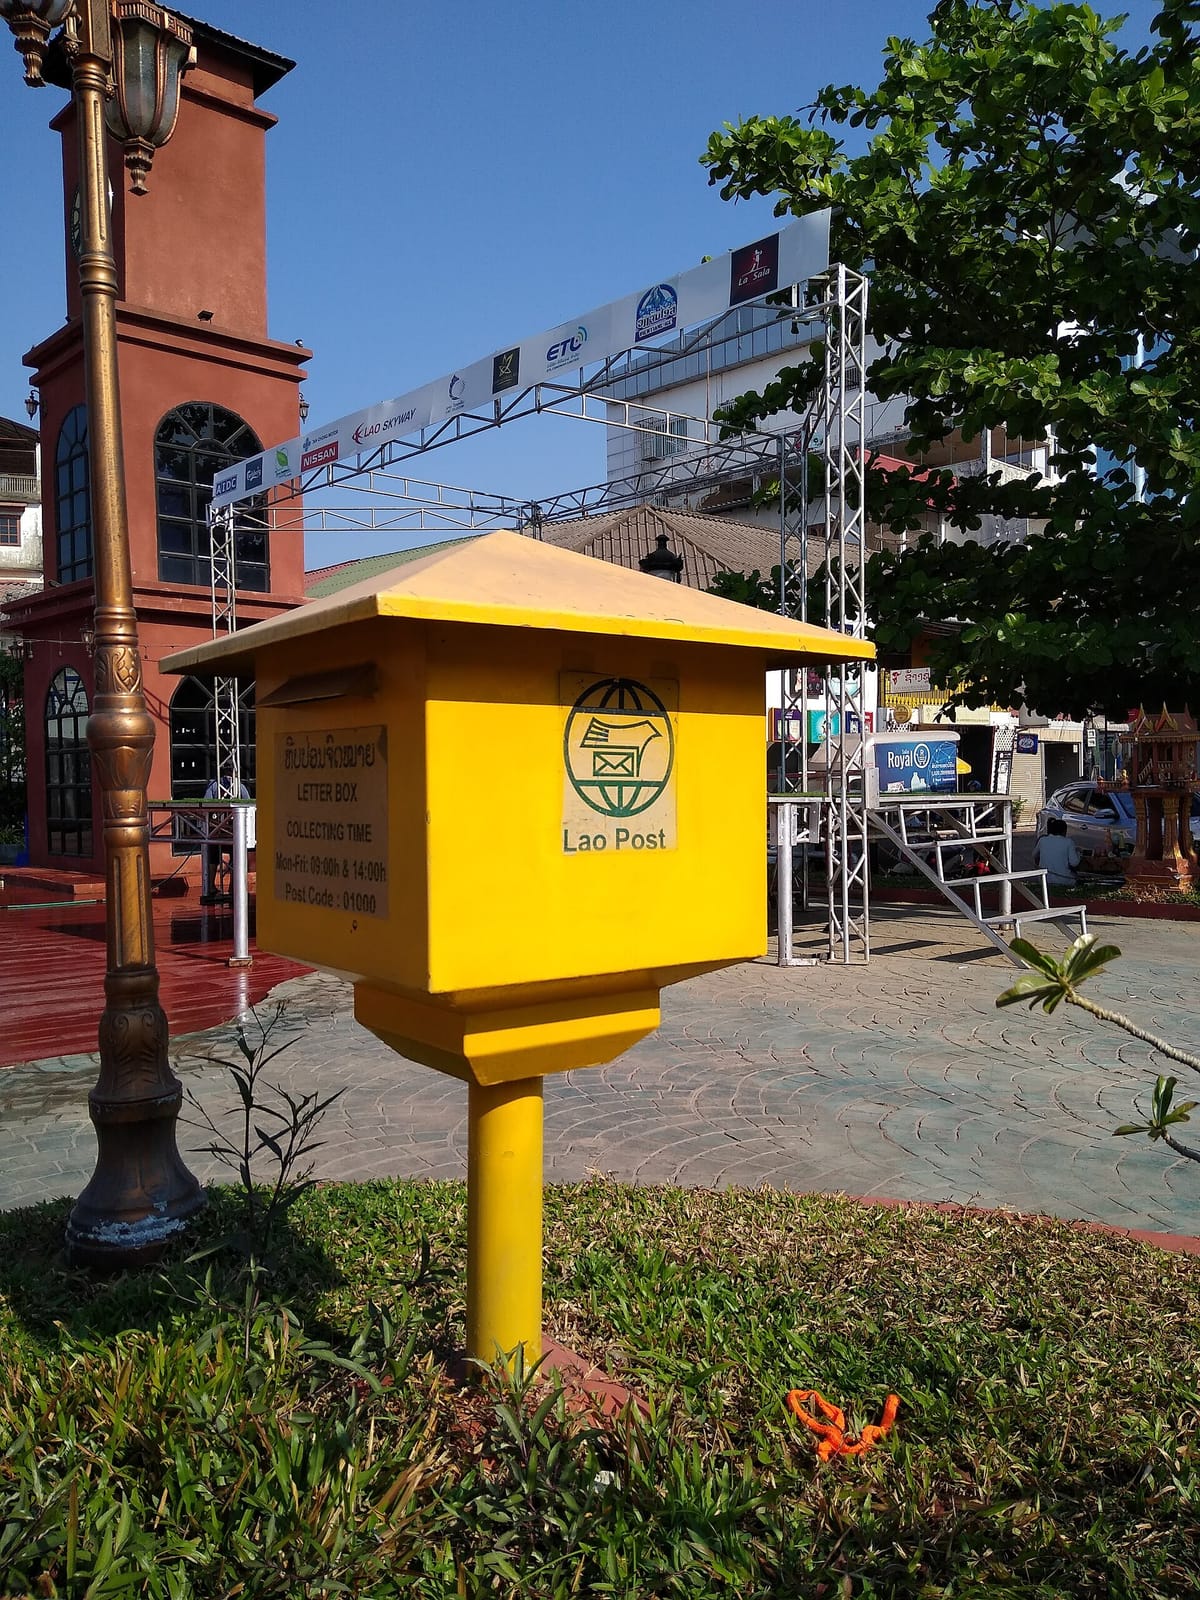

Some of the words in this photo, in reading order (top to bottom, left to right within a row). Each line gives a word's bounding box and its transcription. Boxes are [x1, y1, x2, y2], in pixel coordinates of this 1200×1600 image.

[738, 276, 748, 286] La
[753, 267, 771, 281] Sala
[546, 336, 582, 361] ETL
[364, 423, 380, 437] LAO
[382, 408, 416, 430] SKYWAY
[303, 447, 336, 467] NISSAN
[215, 477, 237, 496] AIDC
[888, 751, 913, 769] Royal
[298, 783, 332, 802] LETTER
[335, 783, 358, 802] BOX
[286, 820, 344, 841] COLLECTING
[346, 823, 373, 843] TIME
[563, 829, 607, 852] Lao
[615, 828, 666, 850] Post
[275, 852, 309, 874] Mon-Fri:
[310, 855, 340, 878] 09:00h
[342, 860, 349, 878] &
[353, 860, 386, 882] 14:00h
[285, 882, 306, 903] Post
[308, 886, 334, 908] Code
[343, 890, 376, 914] 01000
